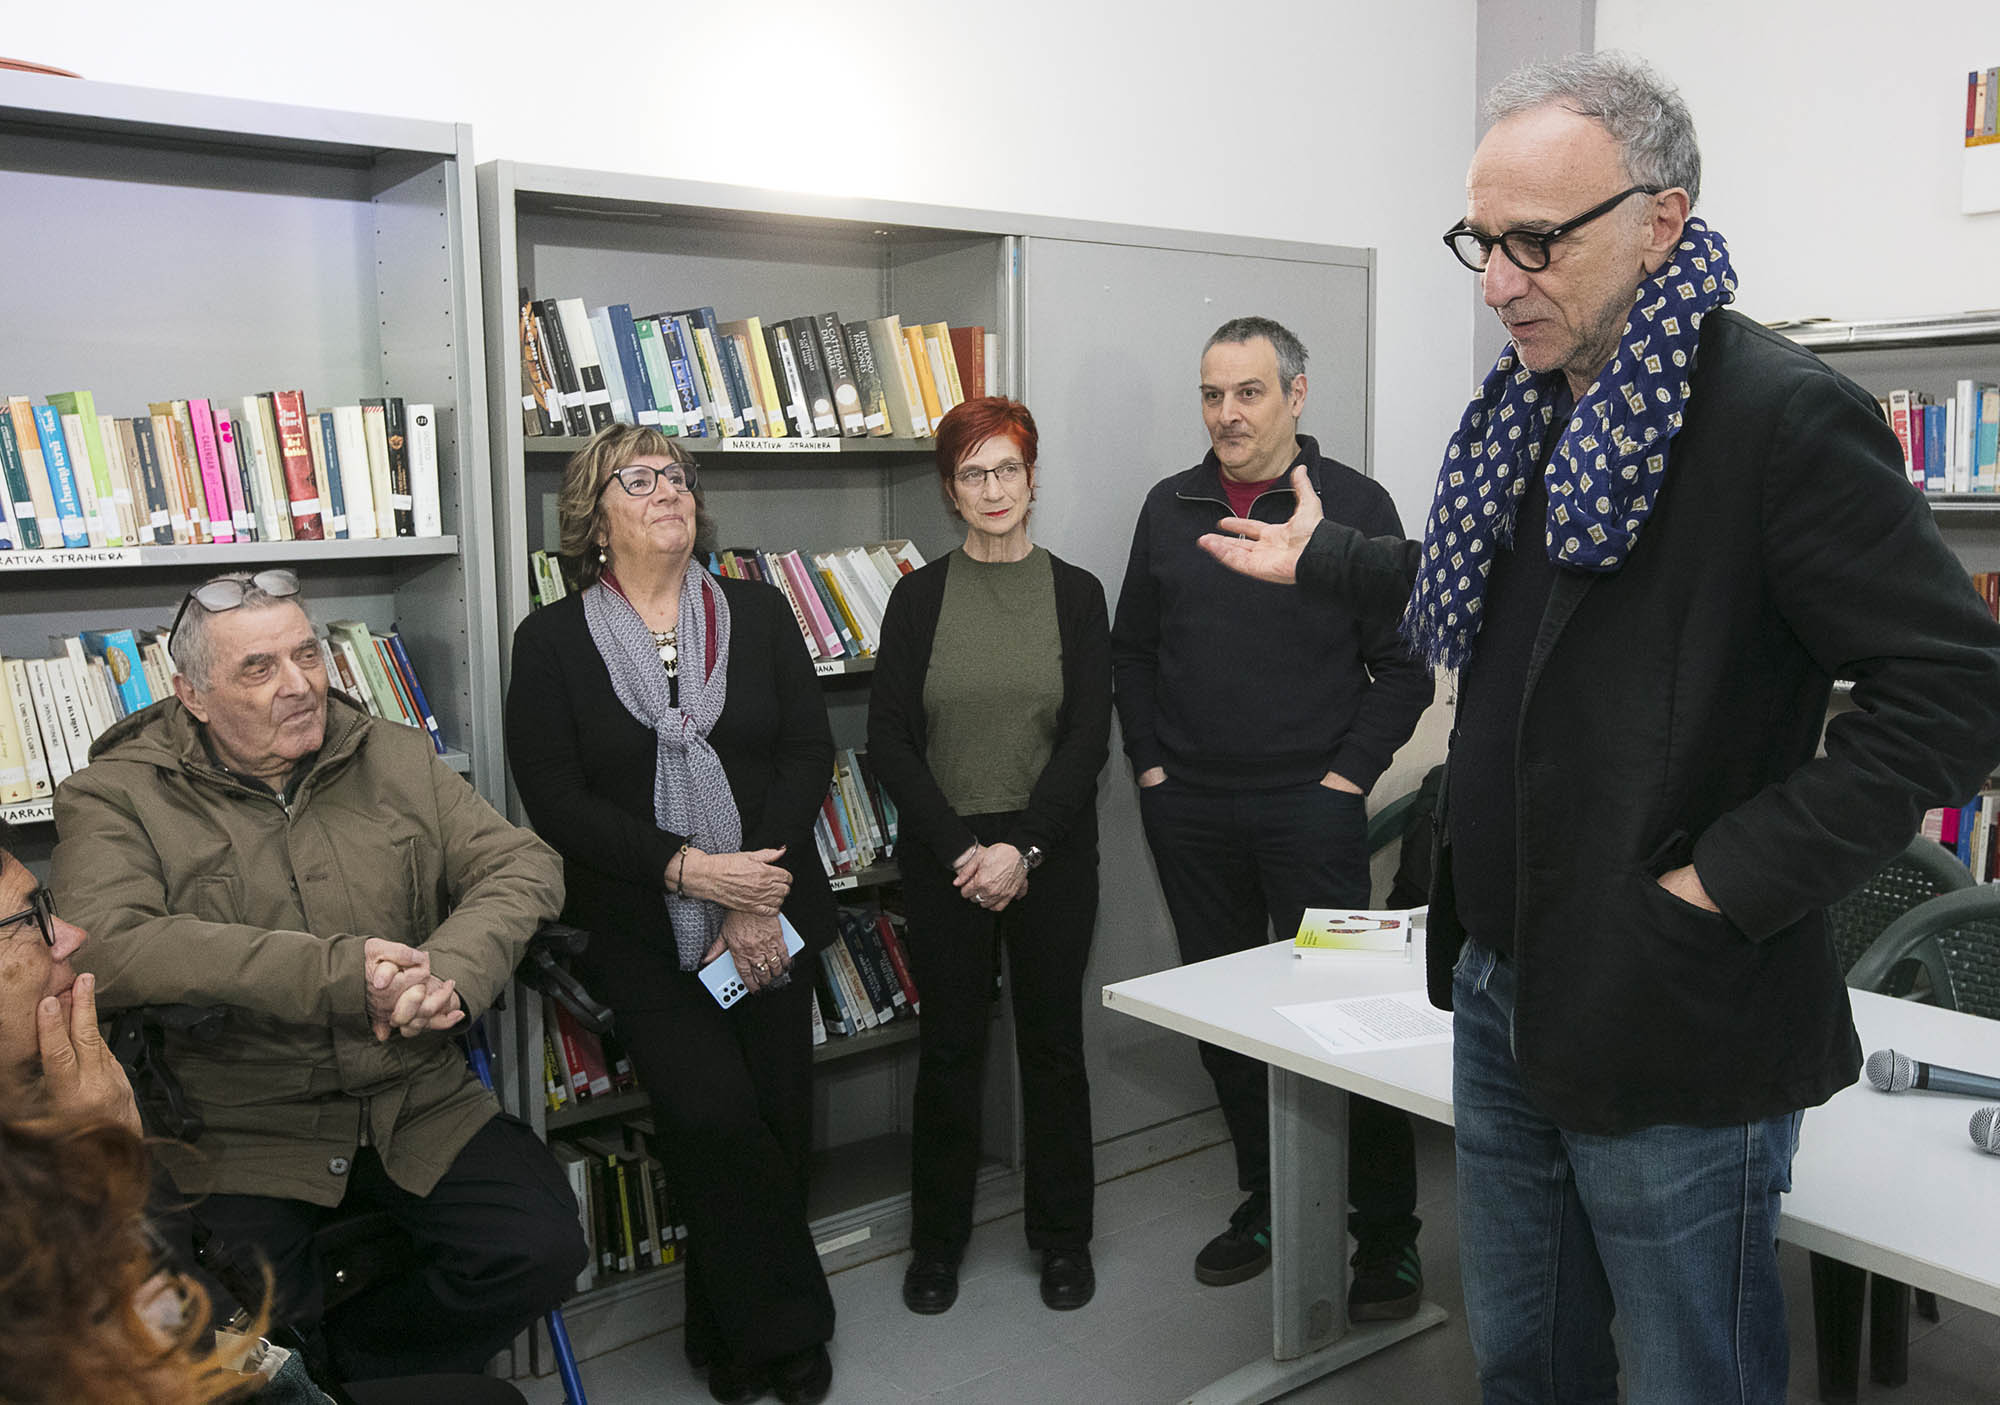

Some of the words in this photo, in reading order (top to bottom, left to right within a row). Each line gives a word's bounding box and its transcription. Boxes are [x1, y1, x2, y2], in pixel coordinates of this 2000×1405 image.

[825, 316, 834, 327] LA
[527, 332, 539, 361] COOPER
[821, 329, 831, 344] DEL
[801, 350, 809, 365] MARE
[803, 338, 815, 371] CATTEDRALE
[825, 346, 836, 369] MARE
[828, 328, 848, 379] CATTEDRALE
[853, 334, 867, 373] FALCONES
[859, 331, 875, 373] ILDEFONSO
[202, 435, 215, 470] CALENDAR
[732, 441, 781, 450] NARRATIVA
[789, 441, 831, 449] STRANIERA
[52, 552, 124, 563] STRANIERA
